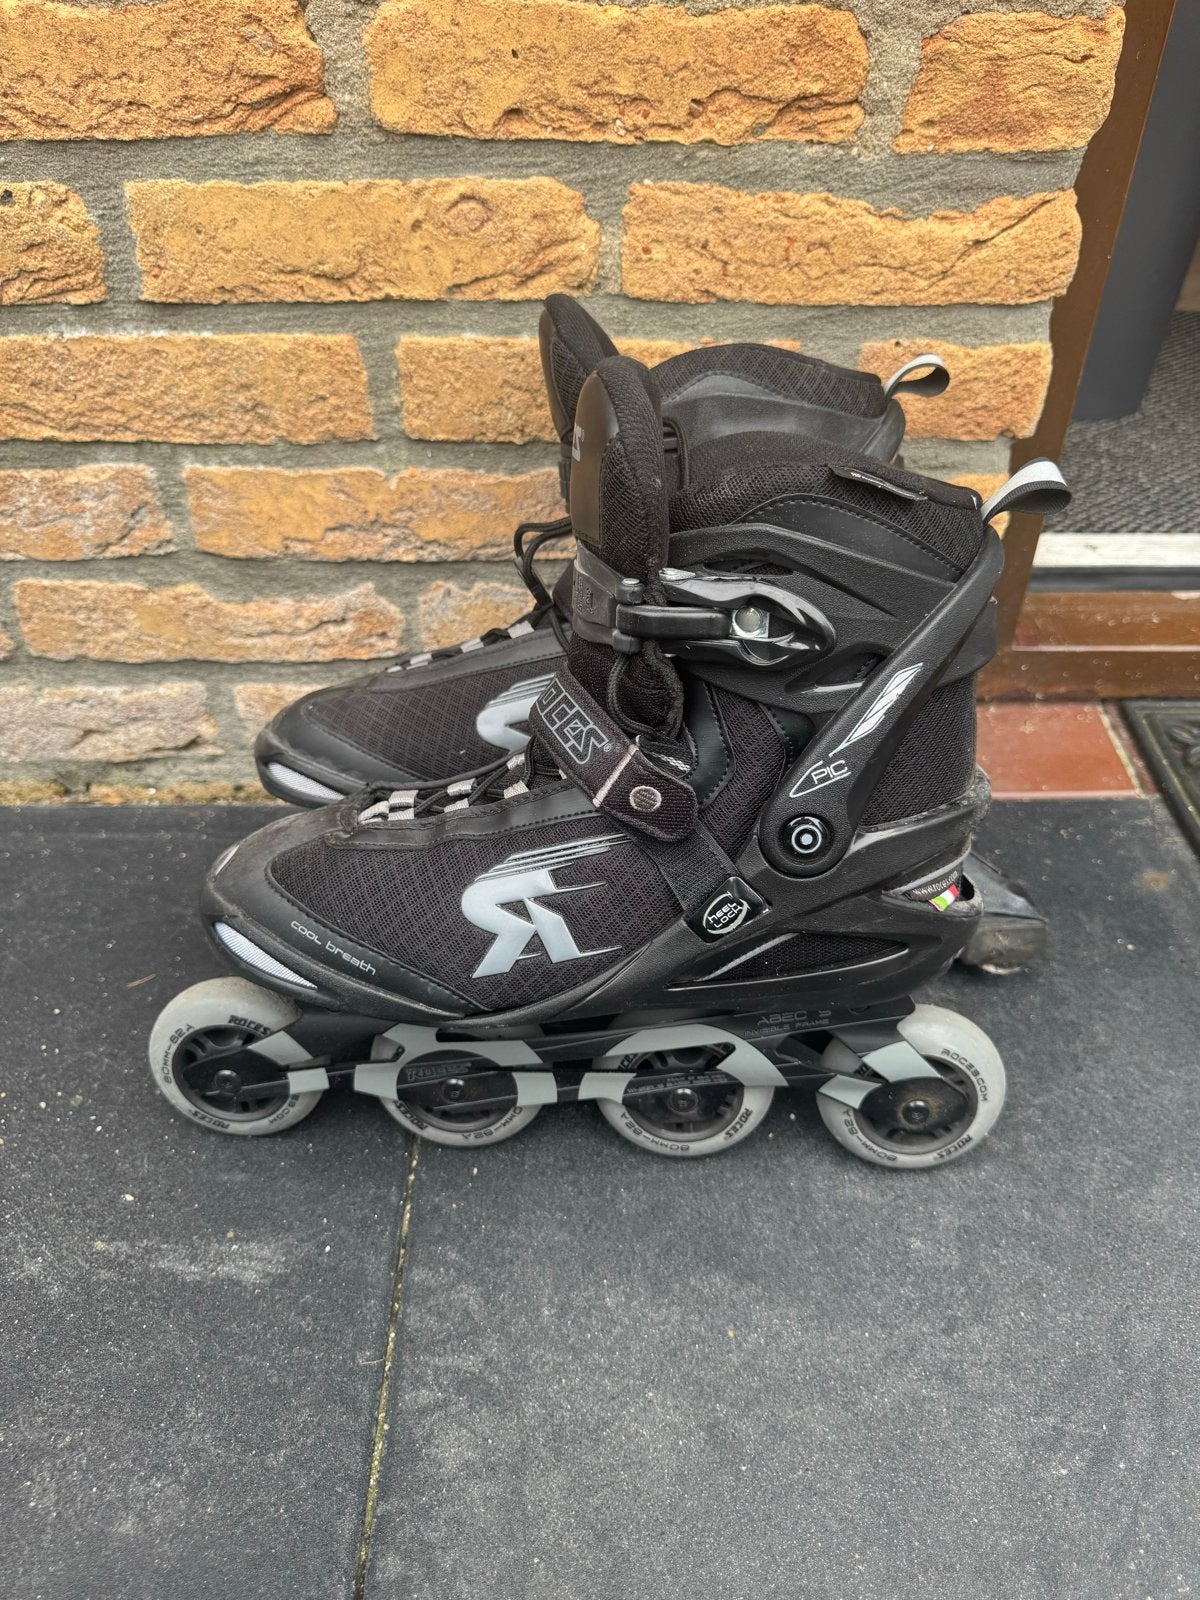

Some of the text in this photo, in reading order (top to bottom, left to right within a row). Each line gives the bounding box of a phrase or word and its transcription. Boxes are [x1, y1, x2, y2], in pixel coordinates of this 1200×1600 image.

[536, 677, 609, 764] OCES
[811, 759, 848, 784] PIC
[227, 1014, 271, 1036] ROCES
[744, 1018, 830, 1037] INVISIBLE FRAME
[757, 1010, 808, 1025] ABEC
[160, 1022, 195, 1085] 80MM-82A
[941, 1048, 989, 1103] ROCES.COM
[192, 1110, 231, 1130] ROCES
[268, 1094, 301, 1125] ES.COM
[393, 1099, 430, 1131] ROCES
[461, 1105, 524, 1140] 0MM-82A
[725, 1107, 753, 1139] ROCES
[620, 1111, 691, 1152] 80MM-82A
[842, 1108, 898, 1162] 80MM-82A
[937, 1134, 973, 1159] ROCES
